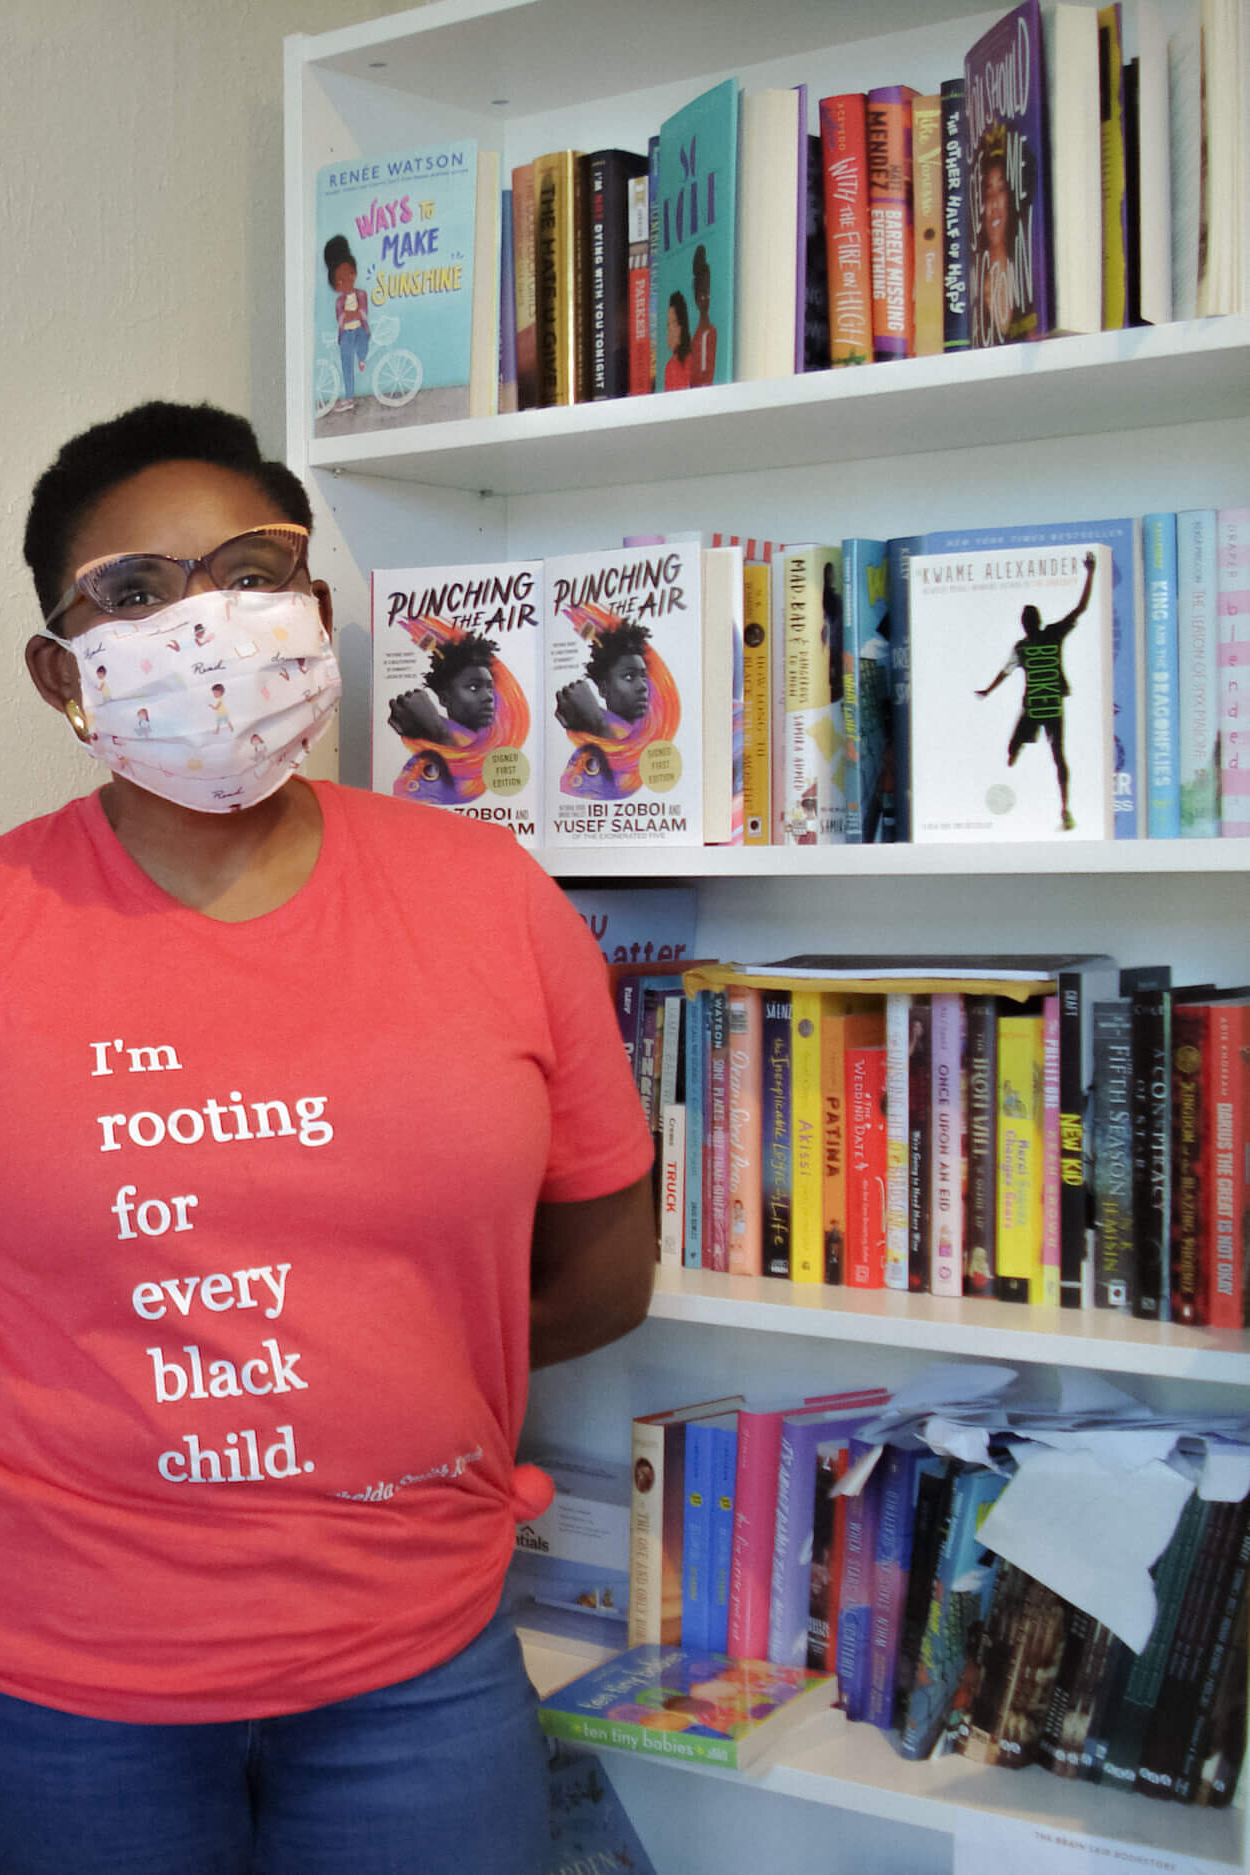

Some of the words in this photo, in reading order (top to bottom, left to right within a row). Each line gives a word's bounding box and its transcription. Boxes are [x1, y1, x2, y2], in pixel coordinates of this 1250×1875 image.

[387, 152, 464, 177] WATSON
[869, 111, 889, 190] MENDEZ
[946, 140, 961, 189] OTHER
[1006, 131, 1028, 213] ME
[594, 171, 603, 192] I'M
[828, 157, 858, 204] WITH
[355, 195, 414, 240] WAYS
[541, 184, 558, 231] THE
[839, 205, 854, 227] THE
[946, 195, 961, 238] HALF
[381, 228, 440, 269] MAKE
[594, 223, 604, 265] DYING
[833, 230, 861, 270] FIRE
[871, 209, 886, 300] EVERYTHING
[886, 210, 903, 264] BARELY
[371, 264, 463, 307] SUNSHINE
[540, 238, 558, 298] HATE
[594, 267, 604, 300] WITH
[843, 272, 855, 287] ON
[945, 263, 966, 314] HAPPY
[594, 302, 604, 330] YOU
[635, 279, 646, 340] PARKER
[835, 291, 865, 347] HIGH
[887, 268, 904, 331] MISSING
[595, 331, 605, 389] TONIGHT
[554, 553, 683, 617] PUNCHING
[923, 563, 975, 585] KWAME
[985, 557, 1079, 580] ALEXANDER
[387, 572, 535, 628] PUNCHING
[452, 611, 486, 631] THE
[484, 604, 539, 633] AIR
[609, 596, 638, 616] THE
[638, 587, 687, 620] AIR
[790, 602, 806, 633] BAD
[1151, 580, 1169, 619] KING
[1024, 645, 1063, 719] BOOKED
[1153, 672, 1172, 787] DRAGONFLIES
[492, 778, 522, 789] EDITION
[496, 766, 517, 776] FIRST
[554, 819, 607, 834] YUSEF
[611, 817, 687, 833] SALAAM
[587, 804, 609, 818] IBI
[613, 802, 666, 817] ZOBOI
[602, 941, 686, 963] atter
[713, 998, 724, 1049] WATSON
[90, 1038, 182, 1076] I'm
[1109, 1045, 1131, 1104] FIFTH
[853, 1059, 865, 1121] WEDDING
[938, 1064, 950, 1105] ONCE
[97, 1091, 334, 1152] rooting
[826, 1097, 841, 1177] PATINA
[854, 1125, 868, 1158] DATE
[938, 1112, 950, 1154] UPON
[1060, 1113, 1082, 1151] NEW
[1216, 1103, 1233, 1149] DARIUS
[798, 1119, 814, 1177] Akissi
[1109, 1110, 1130, 1196] SEASON
[1217, 1152, 1233, 1175] THE
[665, 1161, 678, 1213] TRUCK
[938, 1162, 950, 1182] AN
[111, 1184, 198, 1240] for
[938, 1188, 950, 1211] EID
[1217, 1178, 1233, 1217] GREAT
[771, 1203, 788, 1246] Life
[1217, 1220, 1233, 1232] IS
[1217, 1235, 1233, 1260] NOT
[132, 1263, 292, 1321] every
[1217, 1263, 1234, 1296] OKAY
[147, 1339, 308, 1403] black
[157, 1425, 315, 1485] child.
[583, 1722, 607, 1739] ten
[612, 1728, 639, 1750] tiny
[643, 1726, 694, 1756] babies
